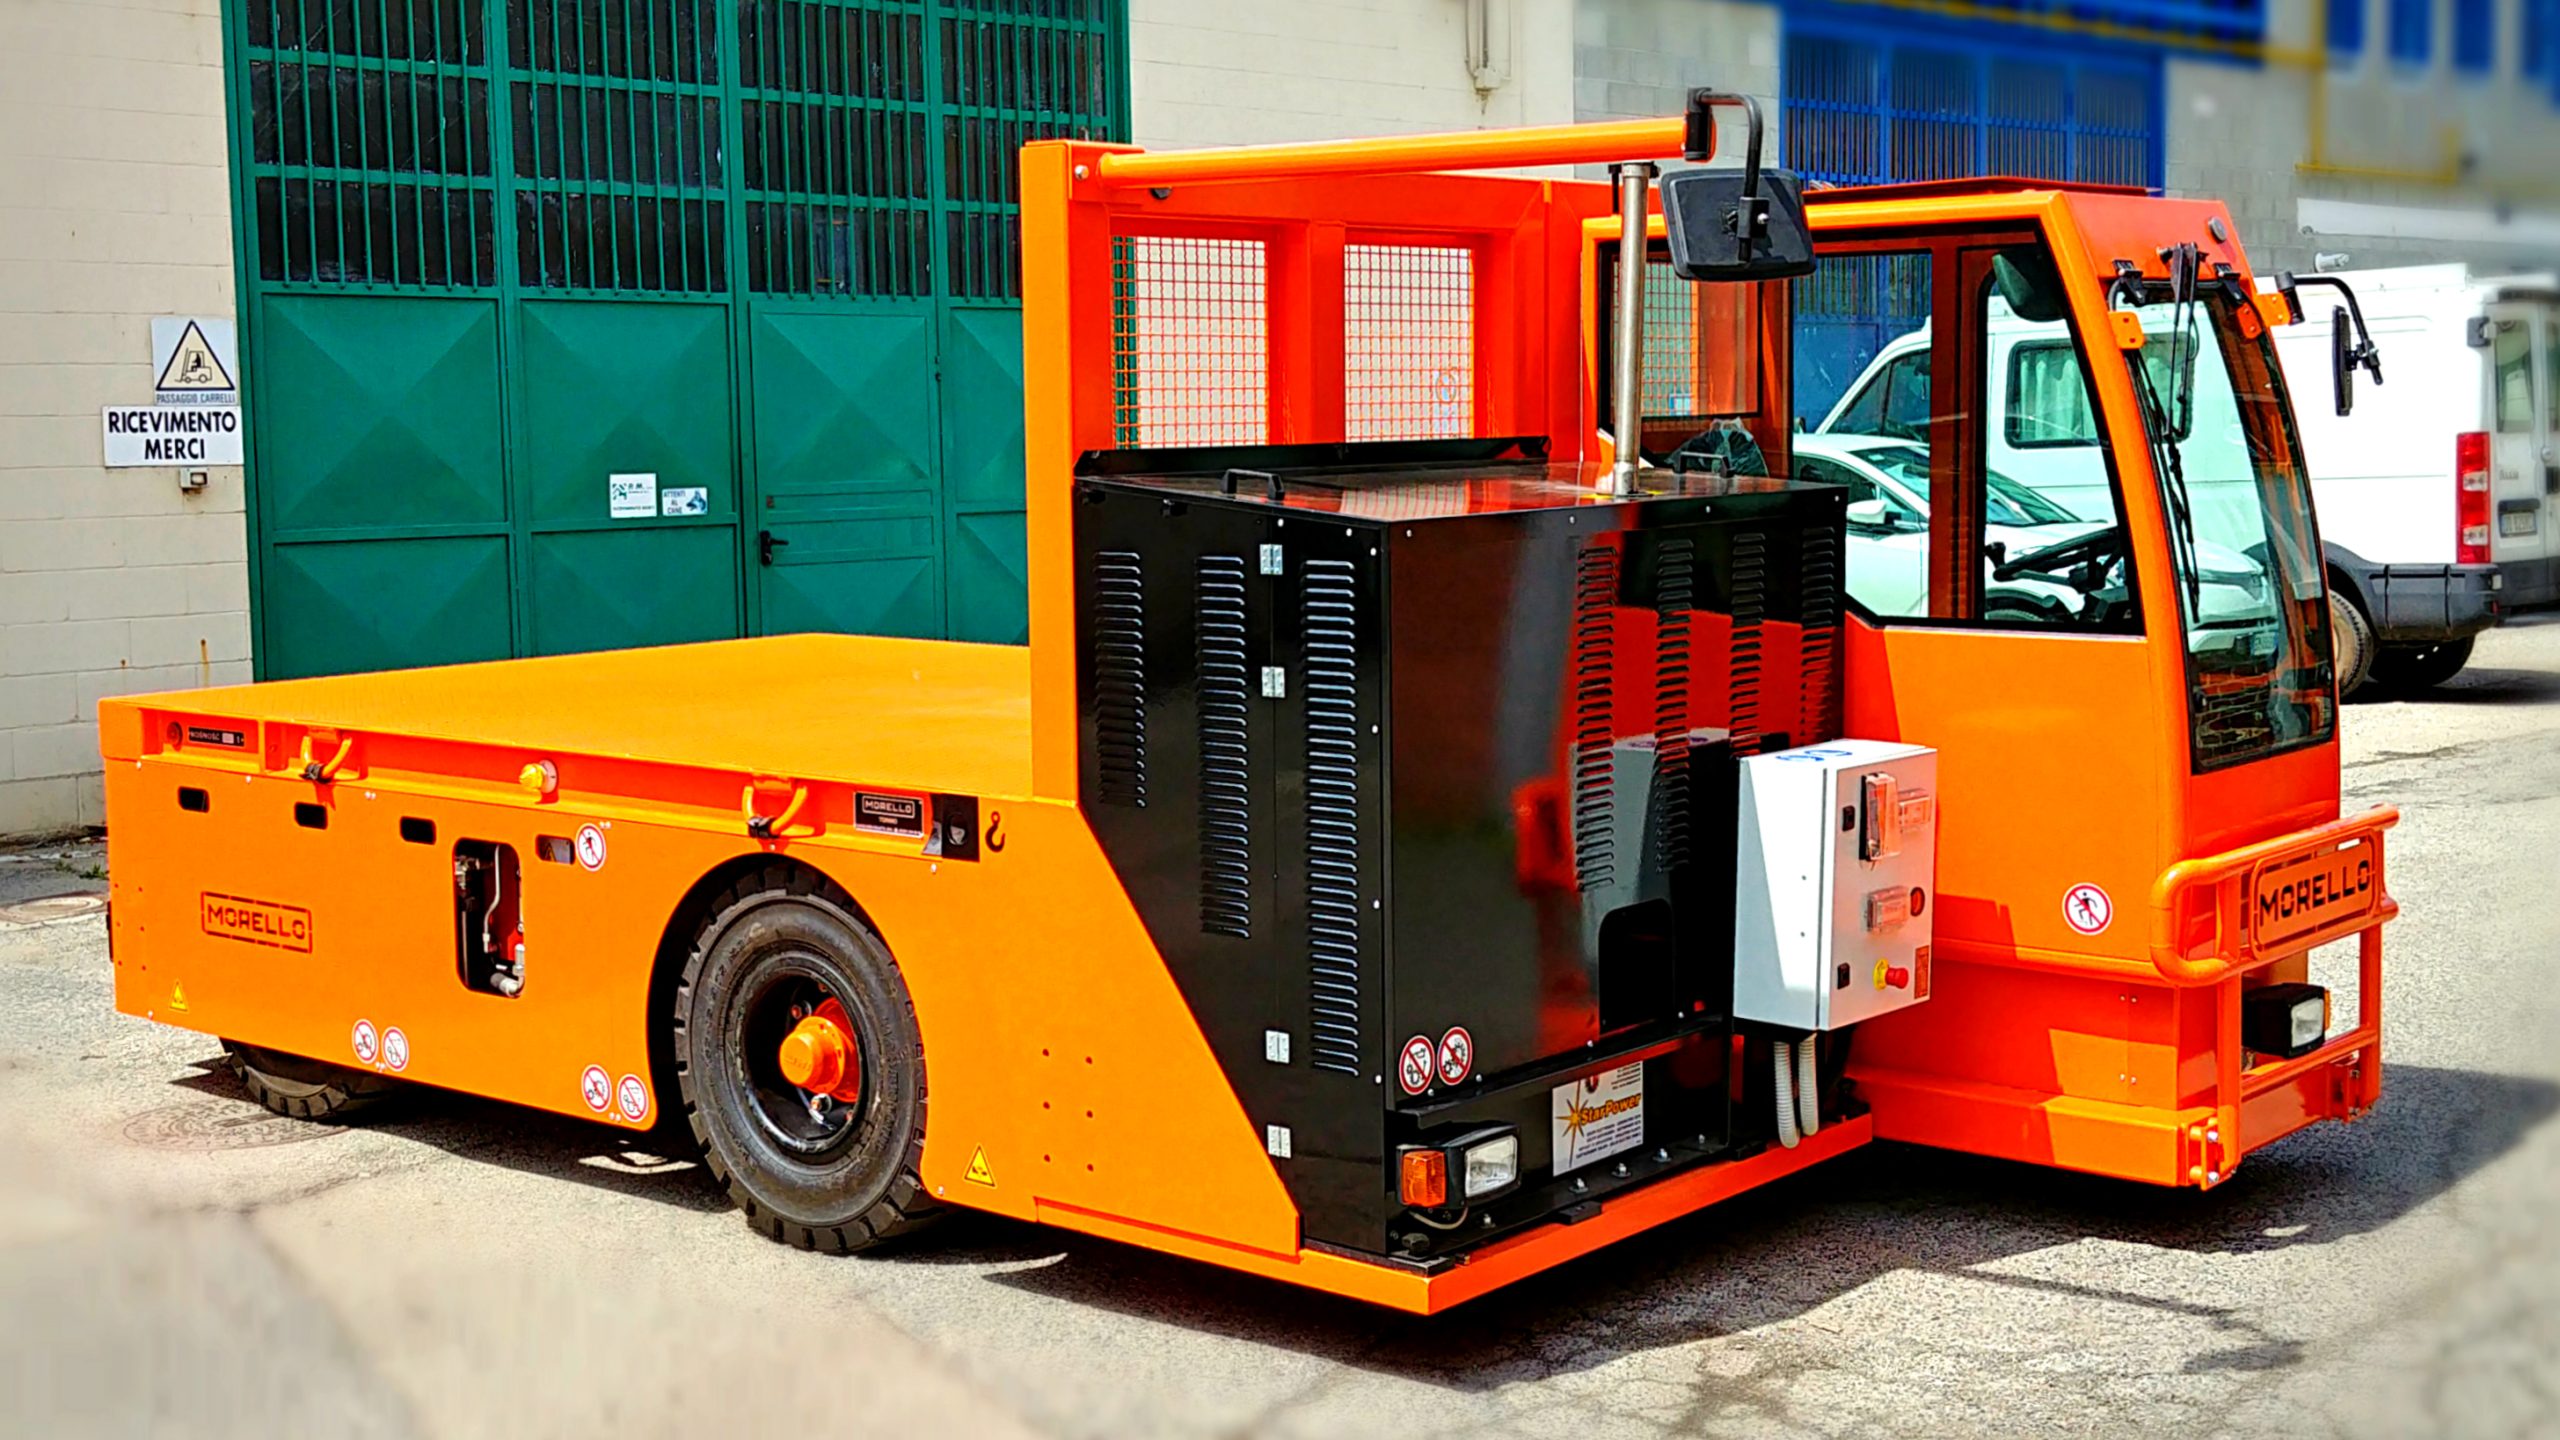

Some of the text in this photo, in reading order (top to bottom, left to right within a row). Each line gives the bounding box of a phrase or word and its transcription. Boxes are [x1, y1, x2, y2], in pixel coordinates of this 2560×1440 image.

[156, 393, 236, 404] PASSAGGIO CARRELLI
[108, 411, 237, 434] RICEVIMENTO
[144, 438, 206, 460] MERCI
[864, 800, 912, 814] MORELLO
[2259, 859, 2371, 928] MORELLO
[207, 903, 306, 940] MORELLO
[1580, 1092, 1642, 1126] StarPower
